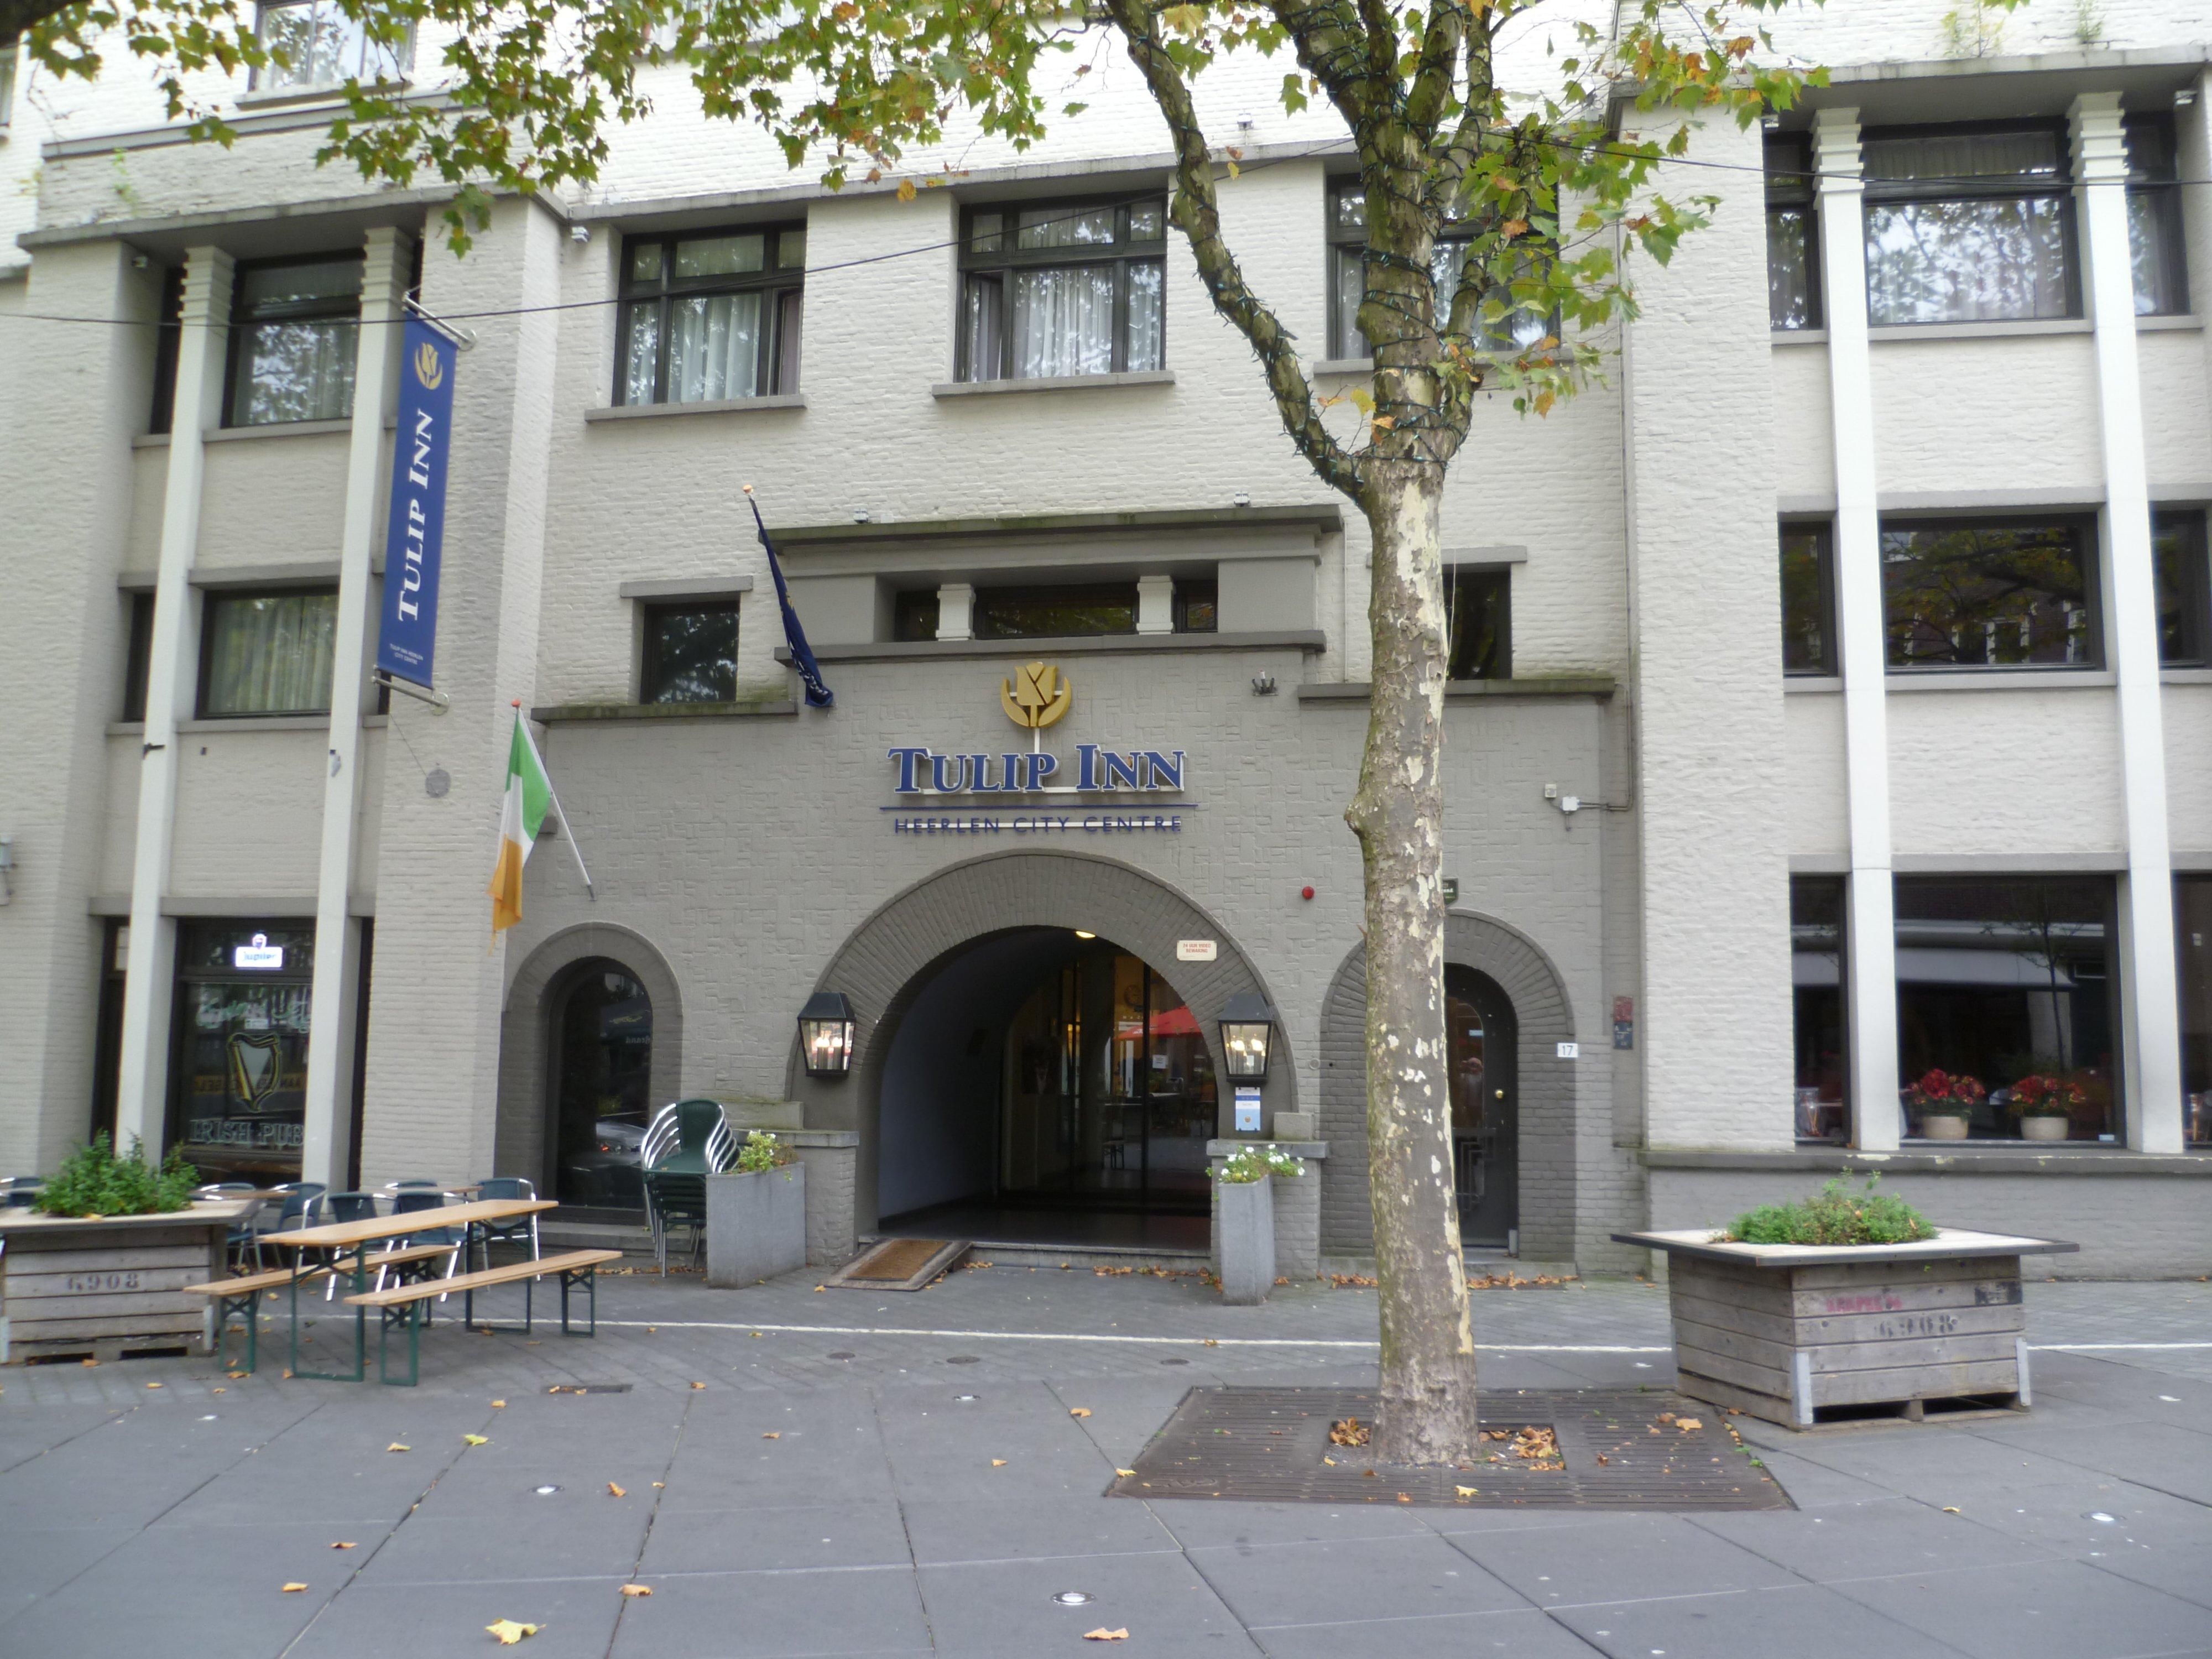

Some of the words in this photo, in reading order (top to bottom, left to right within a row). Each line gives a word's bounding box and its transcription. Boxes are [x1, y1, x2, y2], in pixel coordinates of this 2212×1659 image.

[408, 408, 434, 490] INN
[398, 499, 426, 622] TULIP
[887, 747, 1058, 793] TULIP
[1076, 744, 1187, 792] INN
[895, 817, 1000, 834] HEERLEN
[1013, 816, 1070, 833] CITY
[1083, 816, 1181, 832] CENTRE
[1562, 1045, 1573, 1056] 17
[189, 1118, 252, 1144] IRISH
[258, 1123, 304, 1146] PUB
